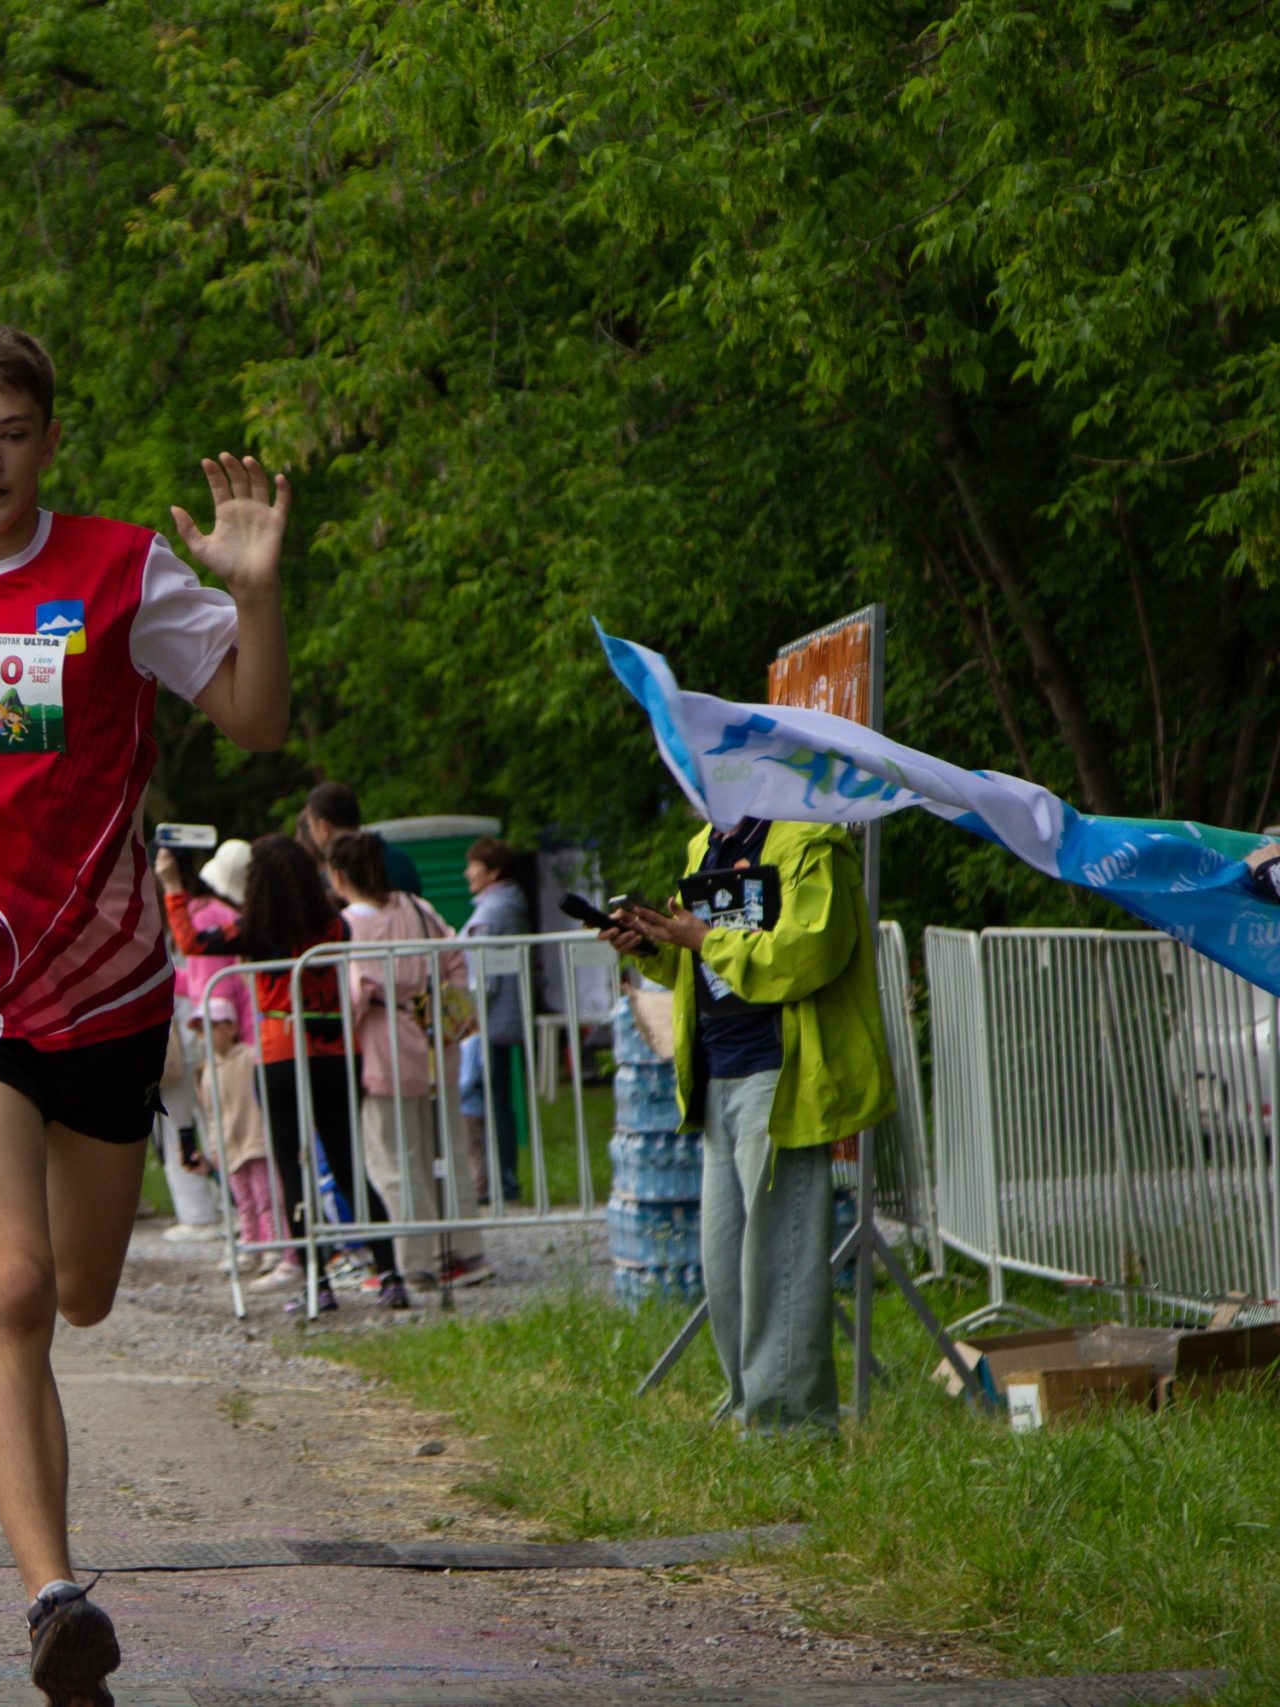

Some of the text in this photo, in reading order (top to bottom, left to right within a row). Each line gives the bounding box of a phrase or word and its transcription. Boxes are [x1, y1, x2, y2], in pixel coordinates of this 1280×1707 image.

[23, 636, 60, 648] ULTRA
[27, 665, 56, 675] ДЕТСКИЙ
[31, 675, 51, 684] ЗАБЕГ
